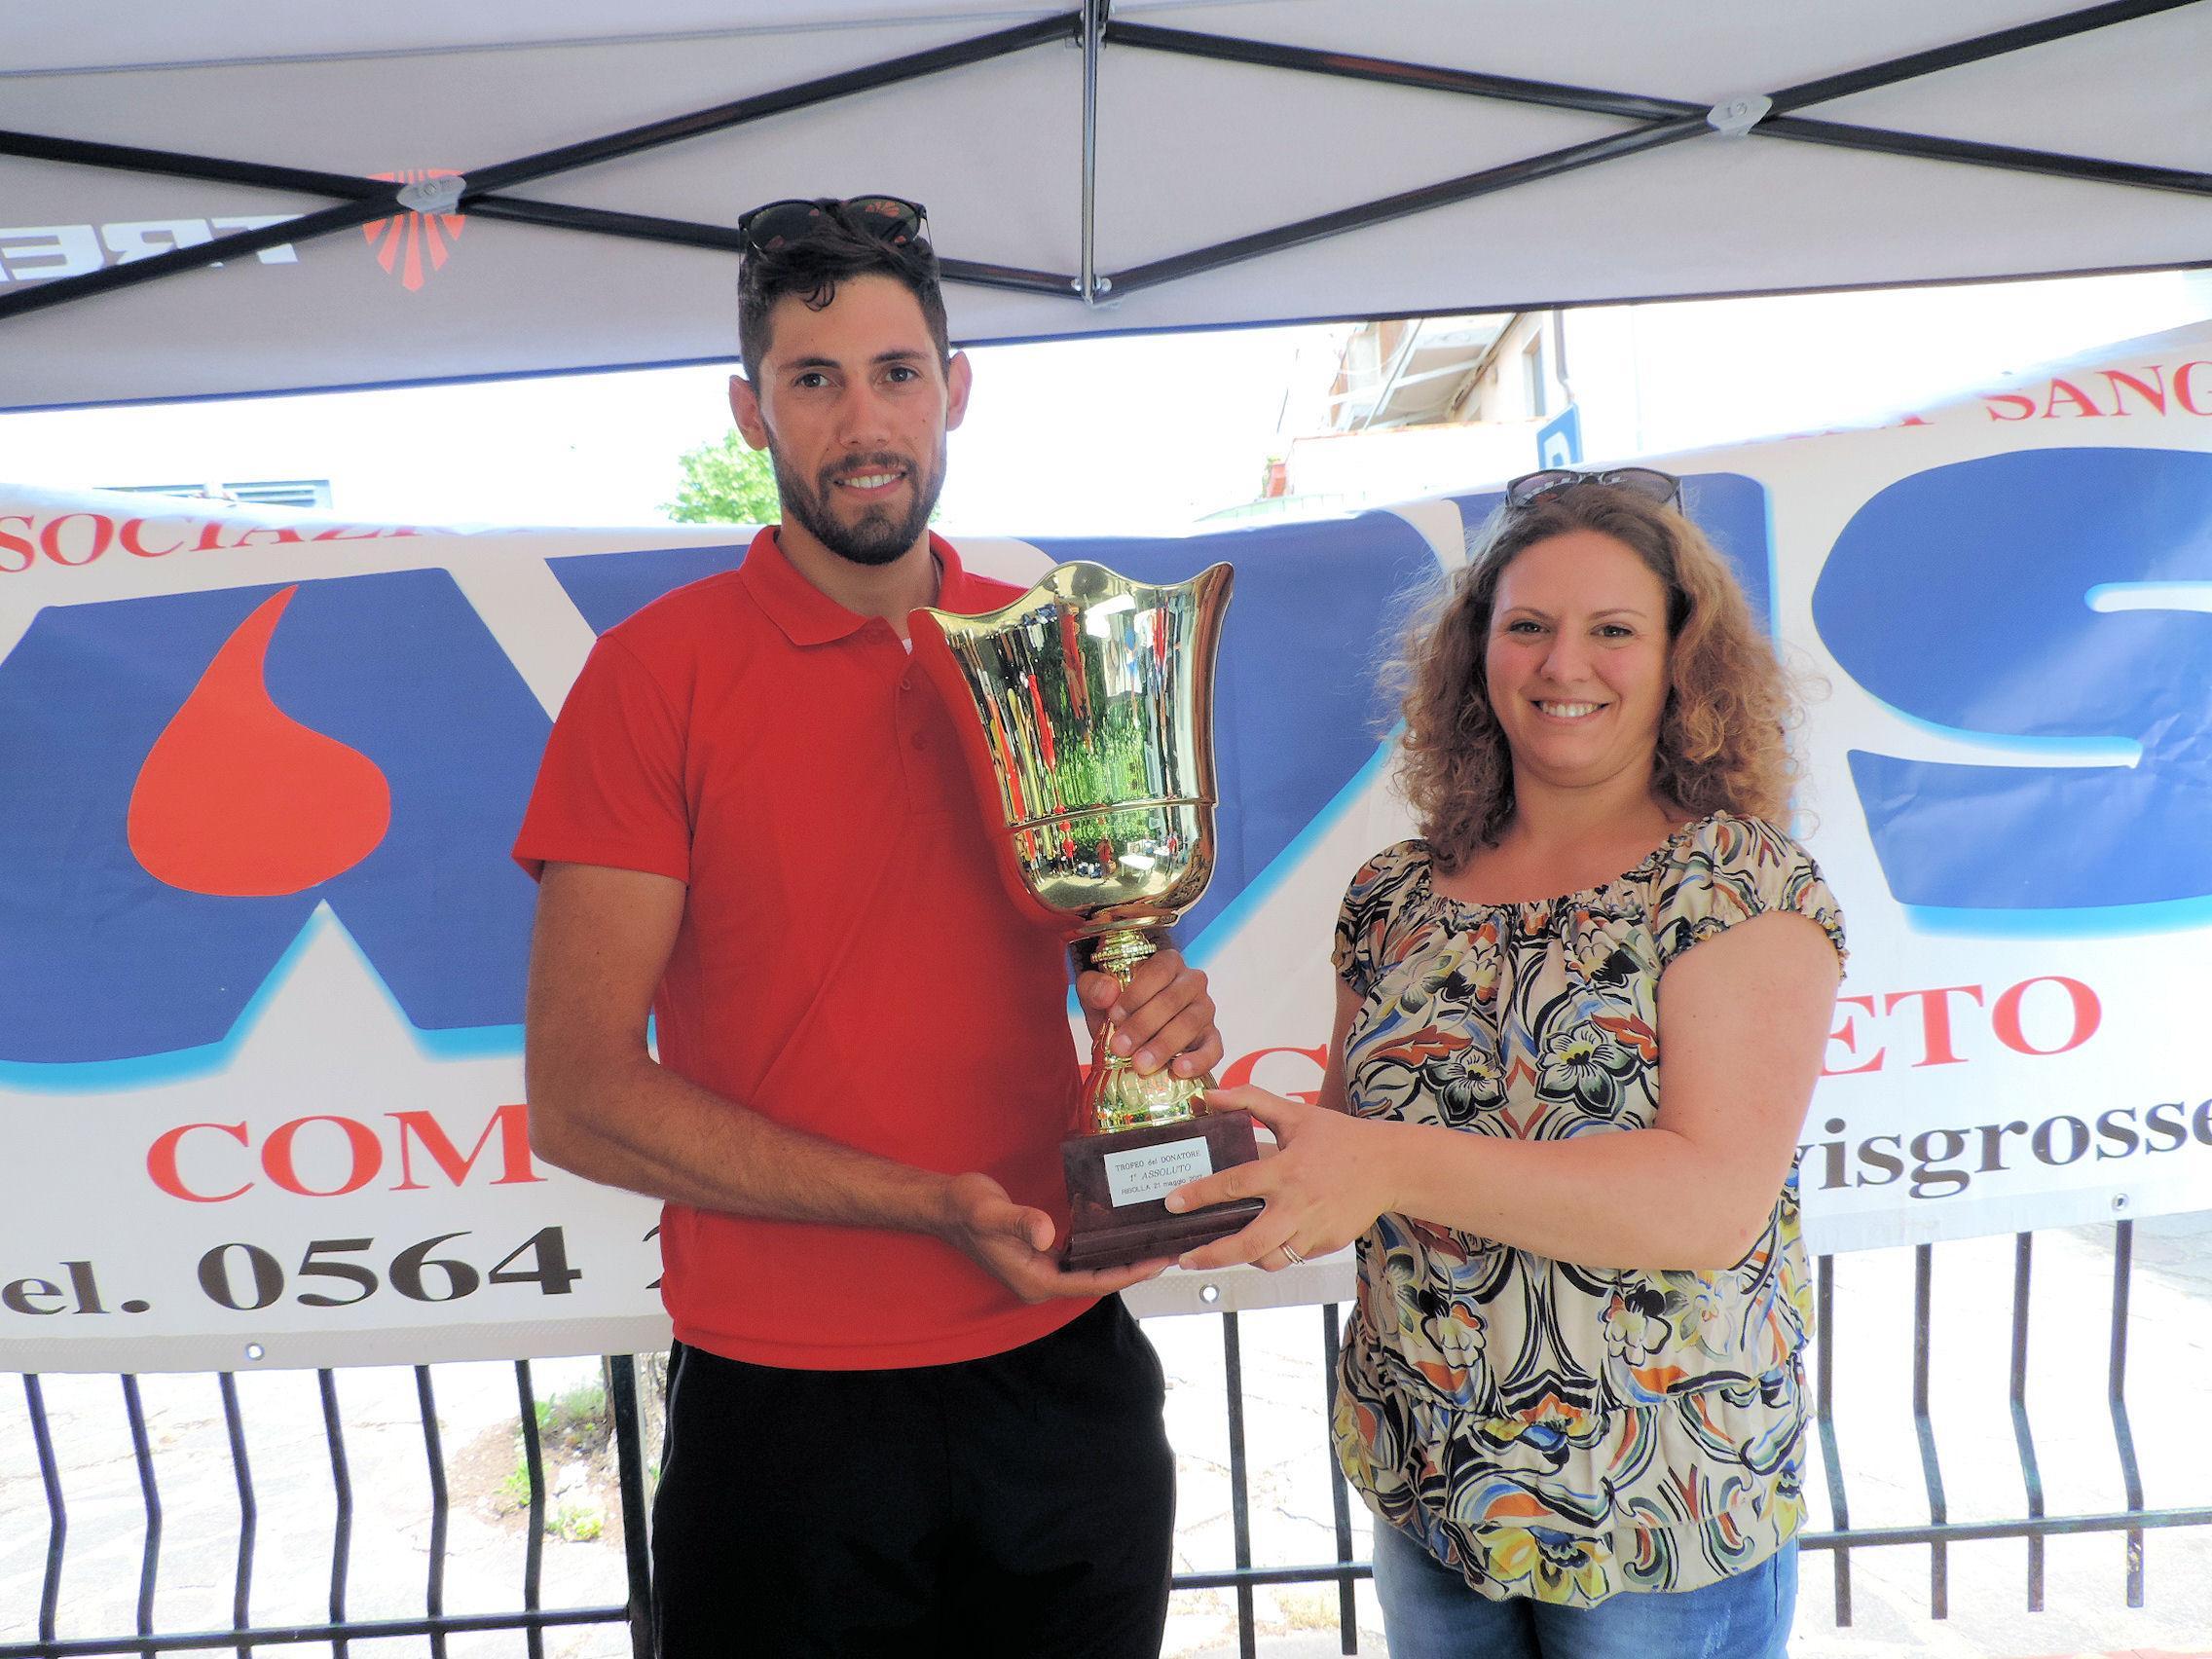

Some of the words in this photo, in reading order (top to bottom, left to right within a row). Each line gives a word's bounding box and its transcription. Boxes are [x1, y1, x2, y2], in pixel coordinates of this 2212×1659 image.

[1115, 1160, 1145, 1171] TROFEO
[1161, 1150, 1201, 1163] DONATORE
[1142, 1163, 1192, 1180] ASSOLUTO
[2, 1260, 151, 1316] el.
[197, 1225, 582, 1311] 0564
